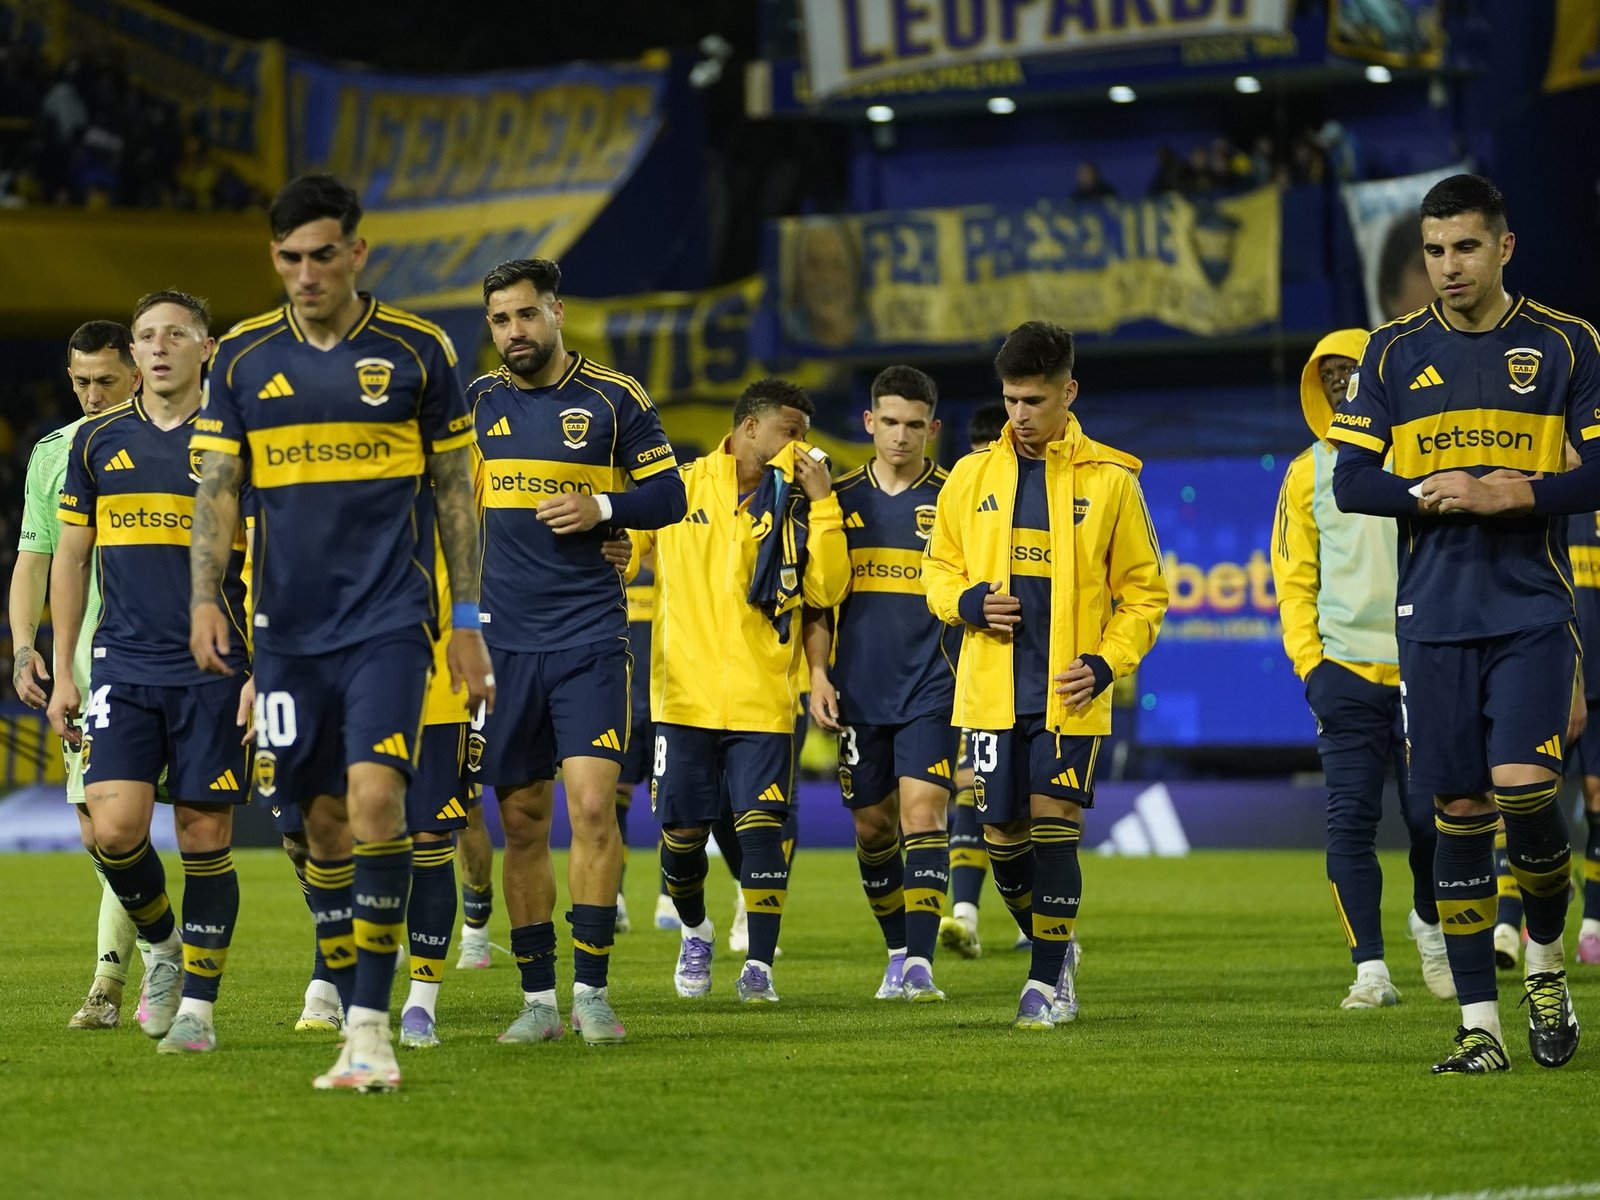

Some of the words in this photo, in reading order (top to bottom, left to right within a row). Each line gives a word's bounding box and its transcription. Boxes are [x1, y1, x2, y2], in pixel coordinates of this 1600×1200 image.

[266, 440, 390, 466] betsson
[1416, 426, 1533, 456] betsson
[490, 472, 593, 497] betsson
[1438, 875, 1490, 888] CABJ
[412, 932, 447, 946] CABJ
